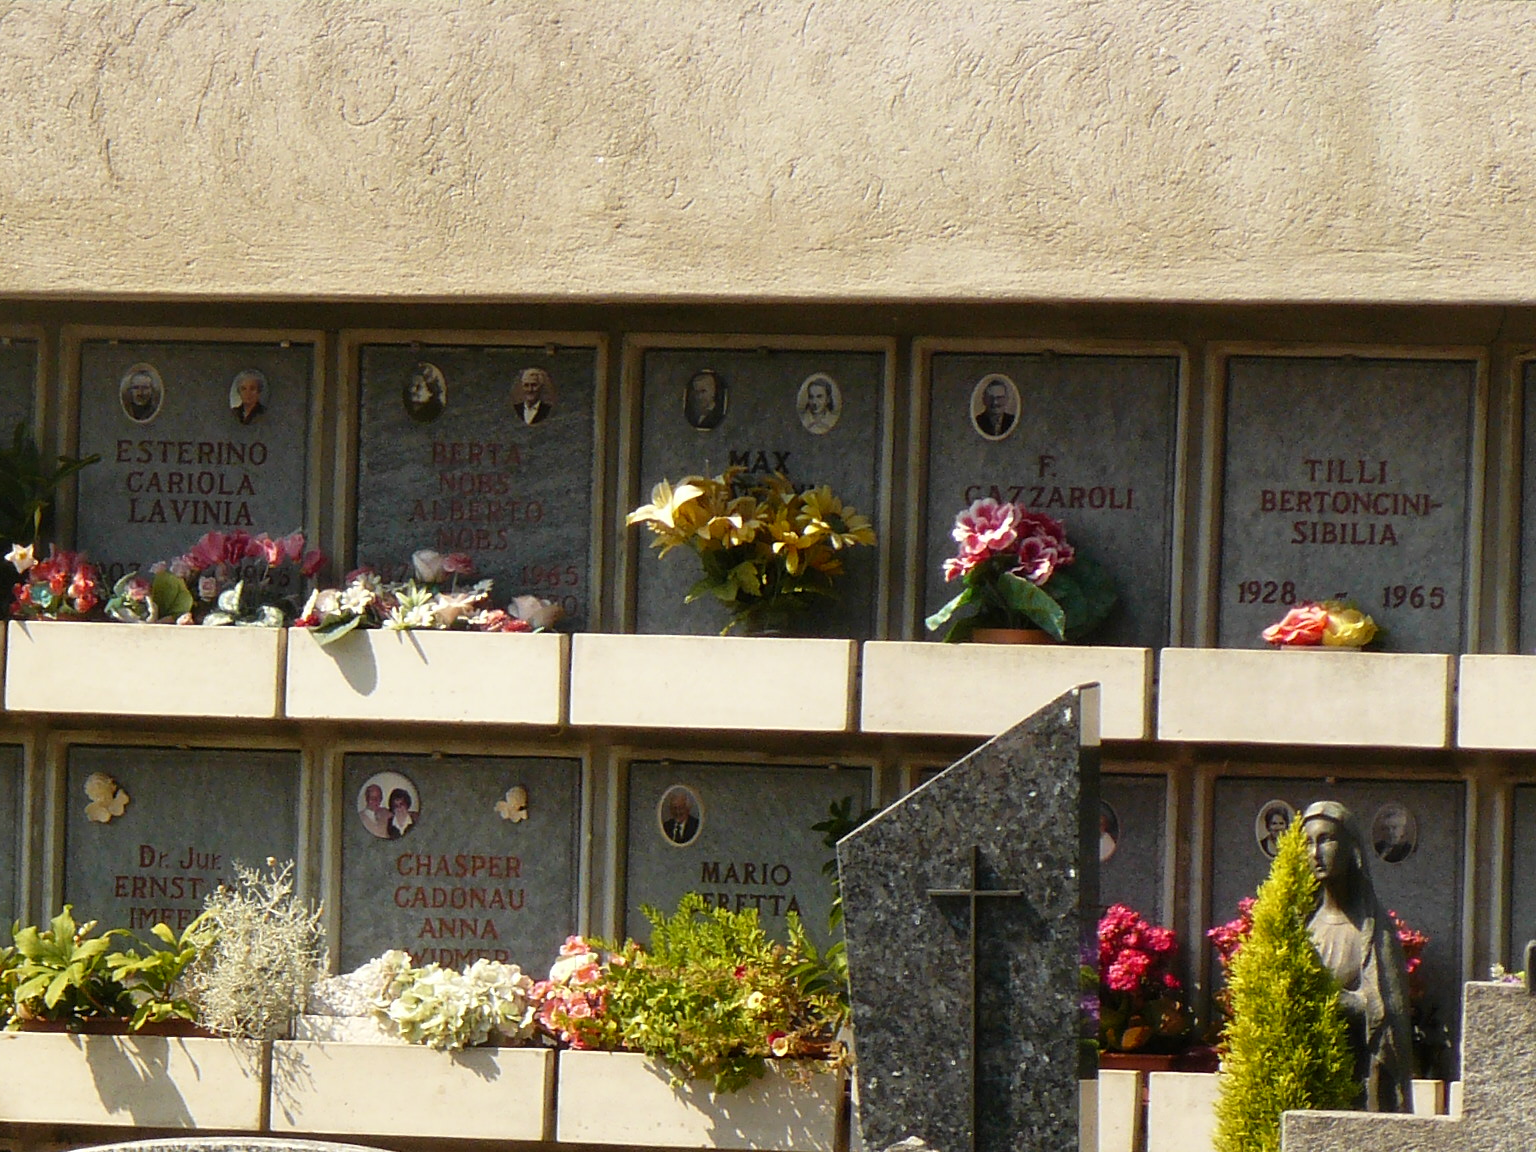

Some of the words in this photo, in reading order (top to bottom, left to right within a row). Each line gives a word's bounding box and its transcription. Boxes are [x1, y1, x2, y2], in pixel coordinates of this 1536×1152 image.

[116, 438, 269, 466] ESTERINO
[432, 441, 522, 467] BERTA
[728, 450, 791, 475] MAX
[1037, 454, 1058, 478] F.
[1304, 458, 1389, 485] TILLI
[126, 470, 257, 496] CARIOLA
[127, 499, 255, 526] LAVINIA
[406, 499, 544, 523] ALBERTO
[1259, 488, 1444, 517] BERTONCINI-
[436, 526, 509, 552] NOBS
[1290, 520, 1399, 546] SIBILIA
[1236, 580, 1297, 606] 1928
[1380, 585, 1446, 611] 1965
[138, 844, 169, 870] Dr.
[395, 852, 523, 880] CHASPER
[114, 874, 204, 900] ERNST
[700, 860, 794, 888] MARIO
[393, 884, 526, 912] CADONAU
[417, 916, 501, 942] ANNA
[402, 945, 513, 968] WIDMER
